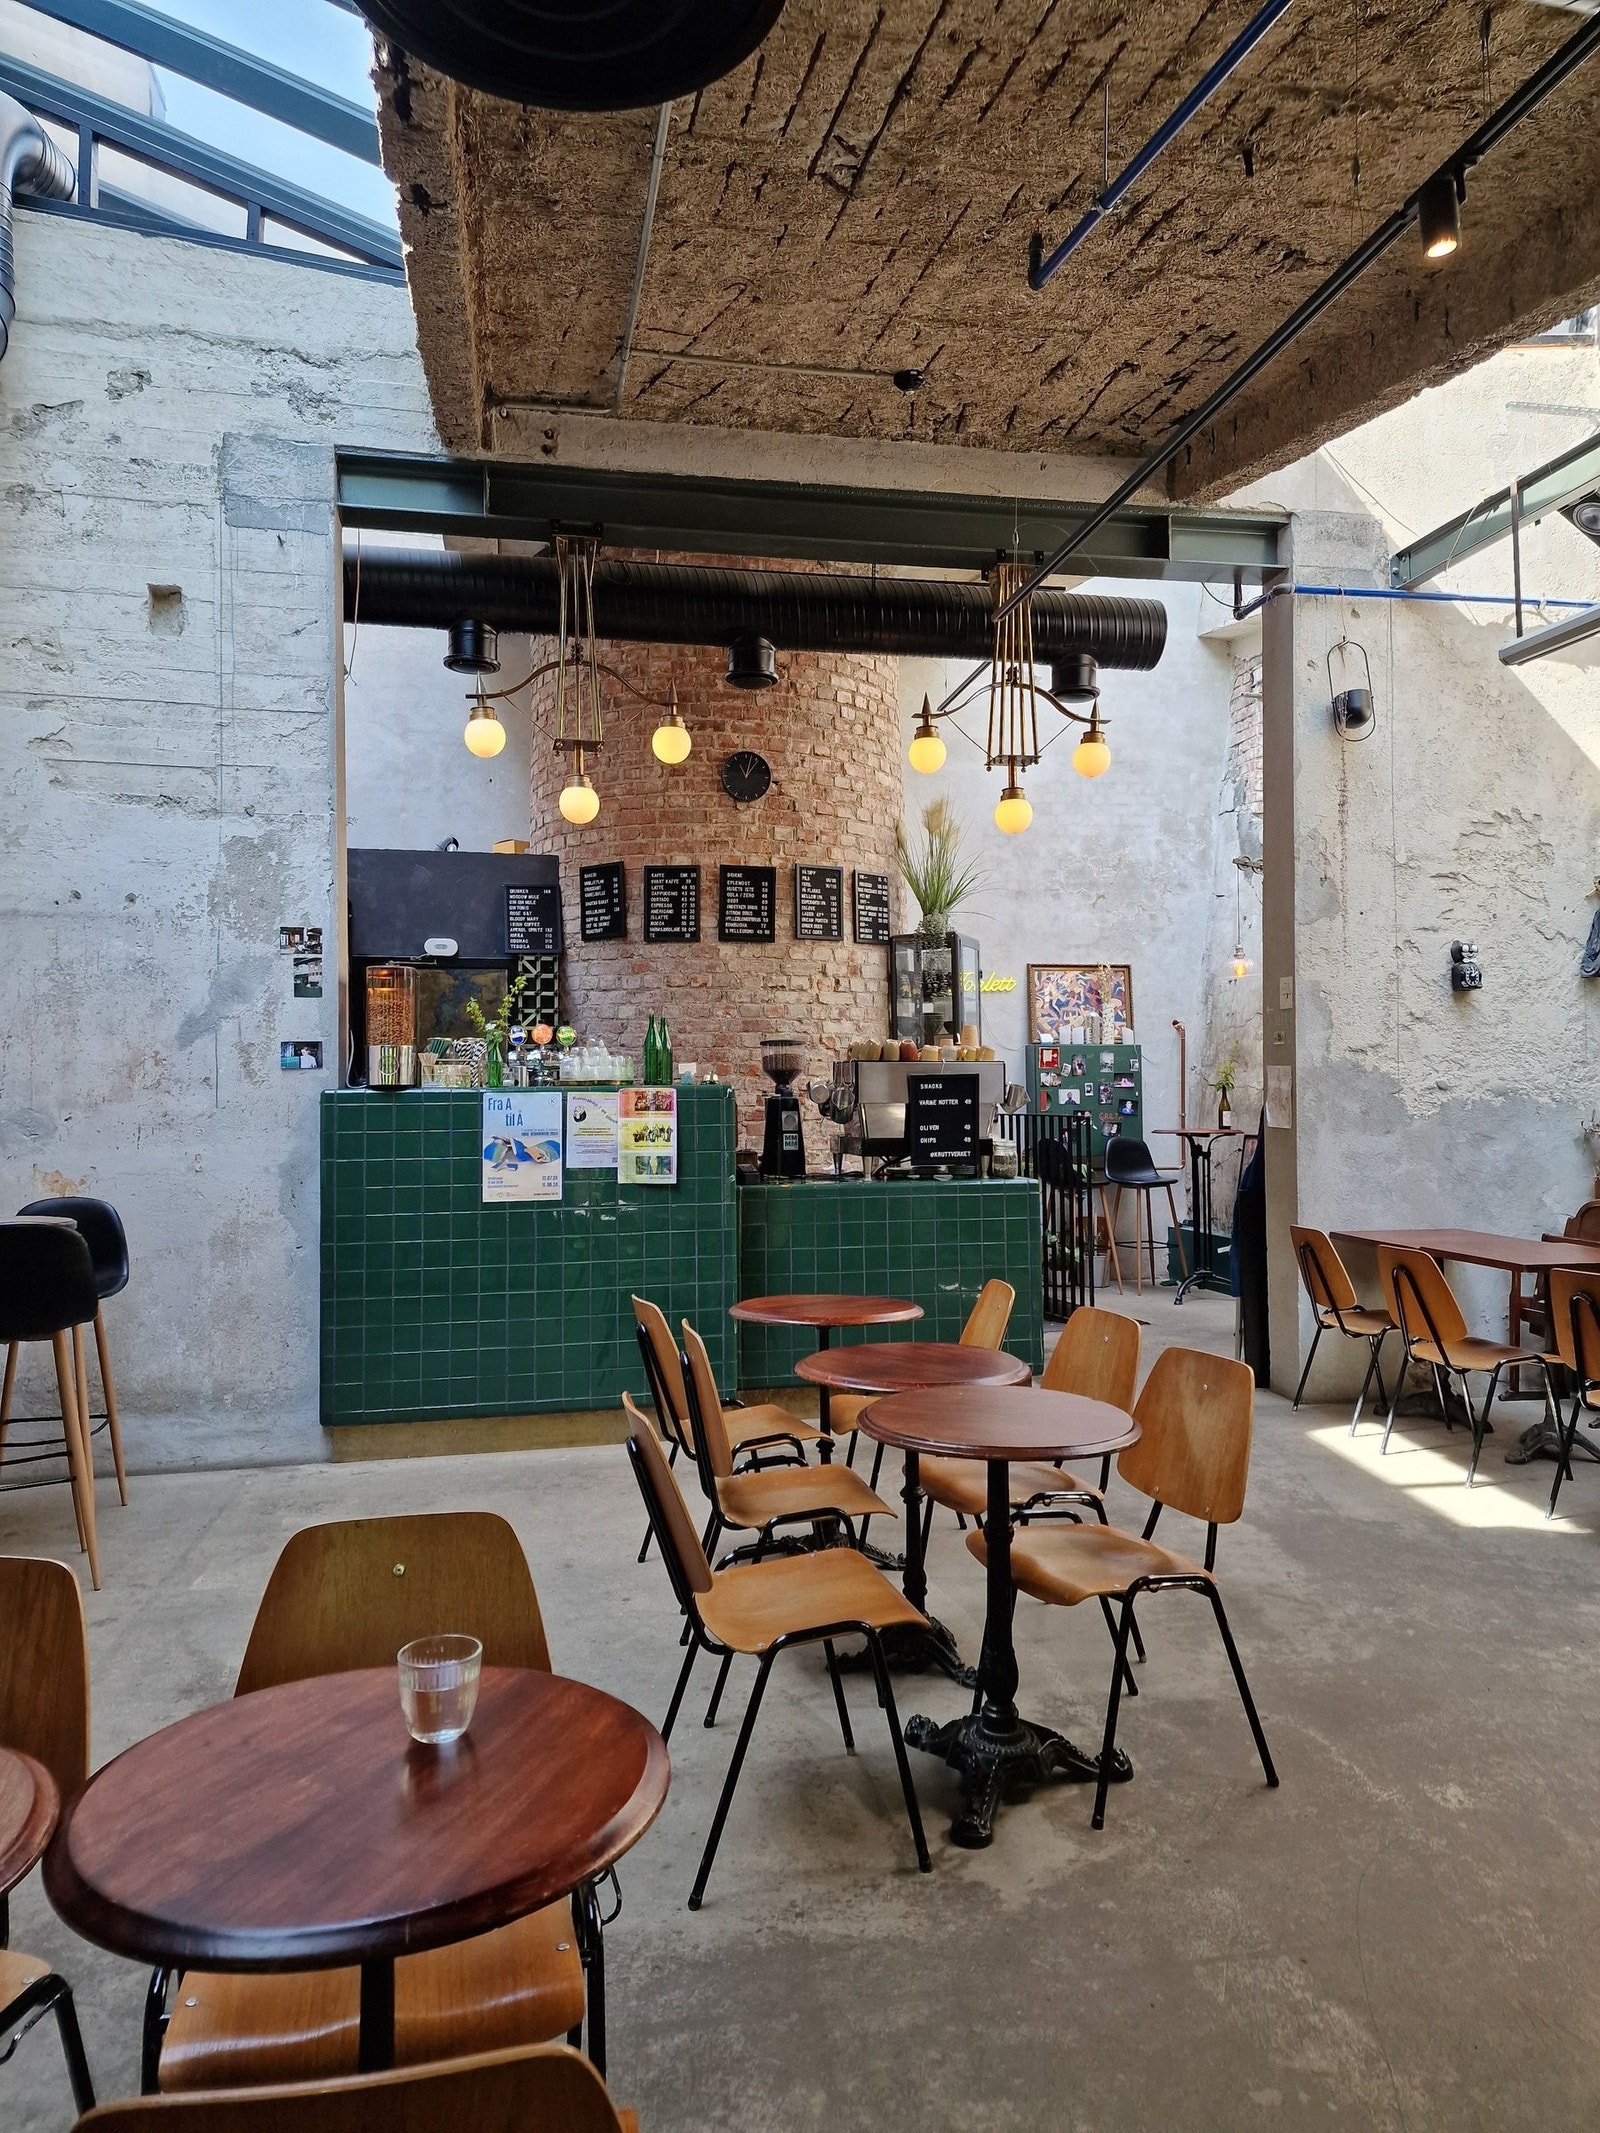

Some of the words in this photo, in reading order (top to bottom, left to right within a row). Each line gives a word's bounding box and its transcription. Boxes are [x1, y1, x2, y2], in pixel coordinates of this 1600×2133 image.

[488, 1098, 503, 1110] Fra
[506, 1098, 512, 1110] A
[506, 1113, 515, 1126] til
[517, 1110, 523, 1126] Å
